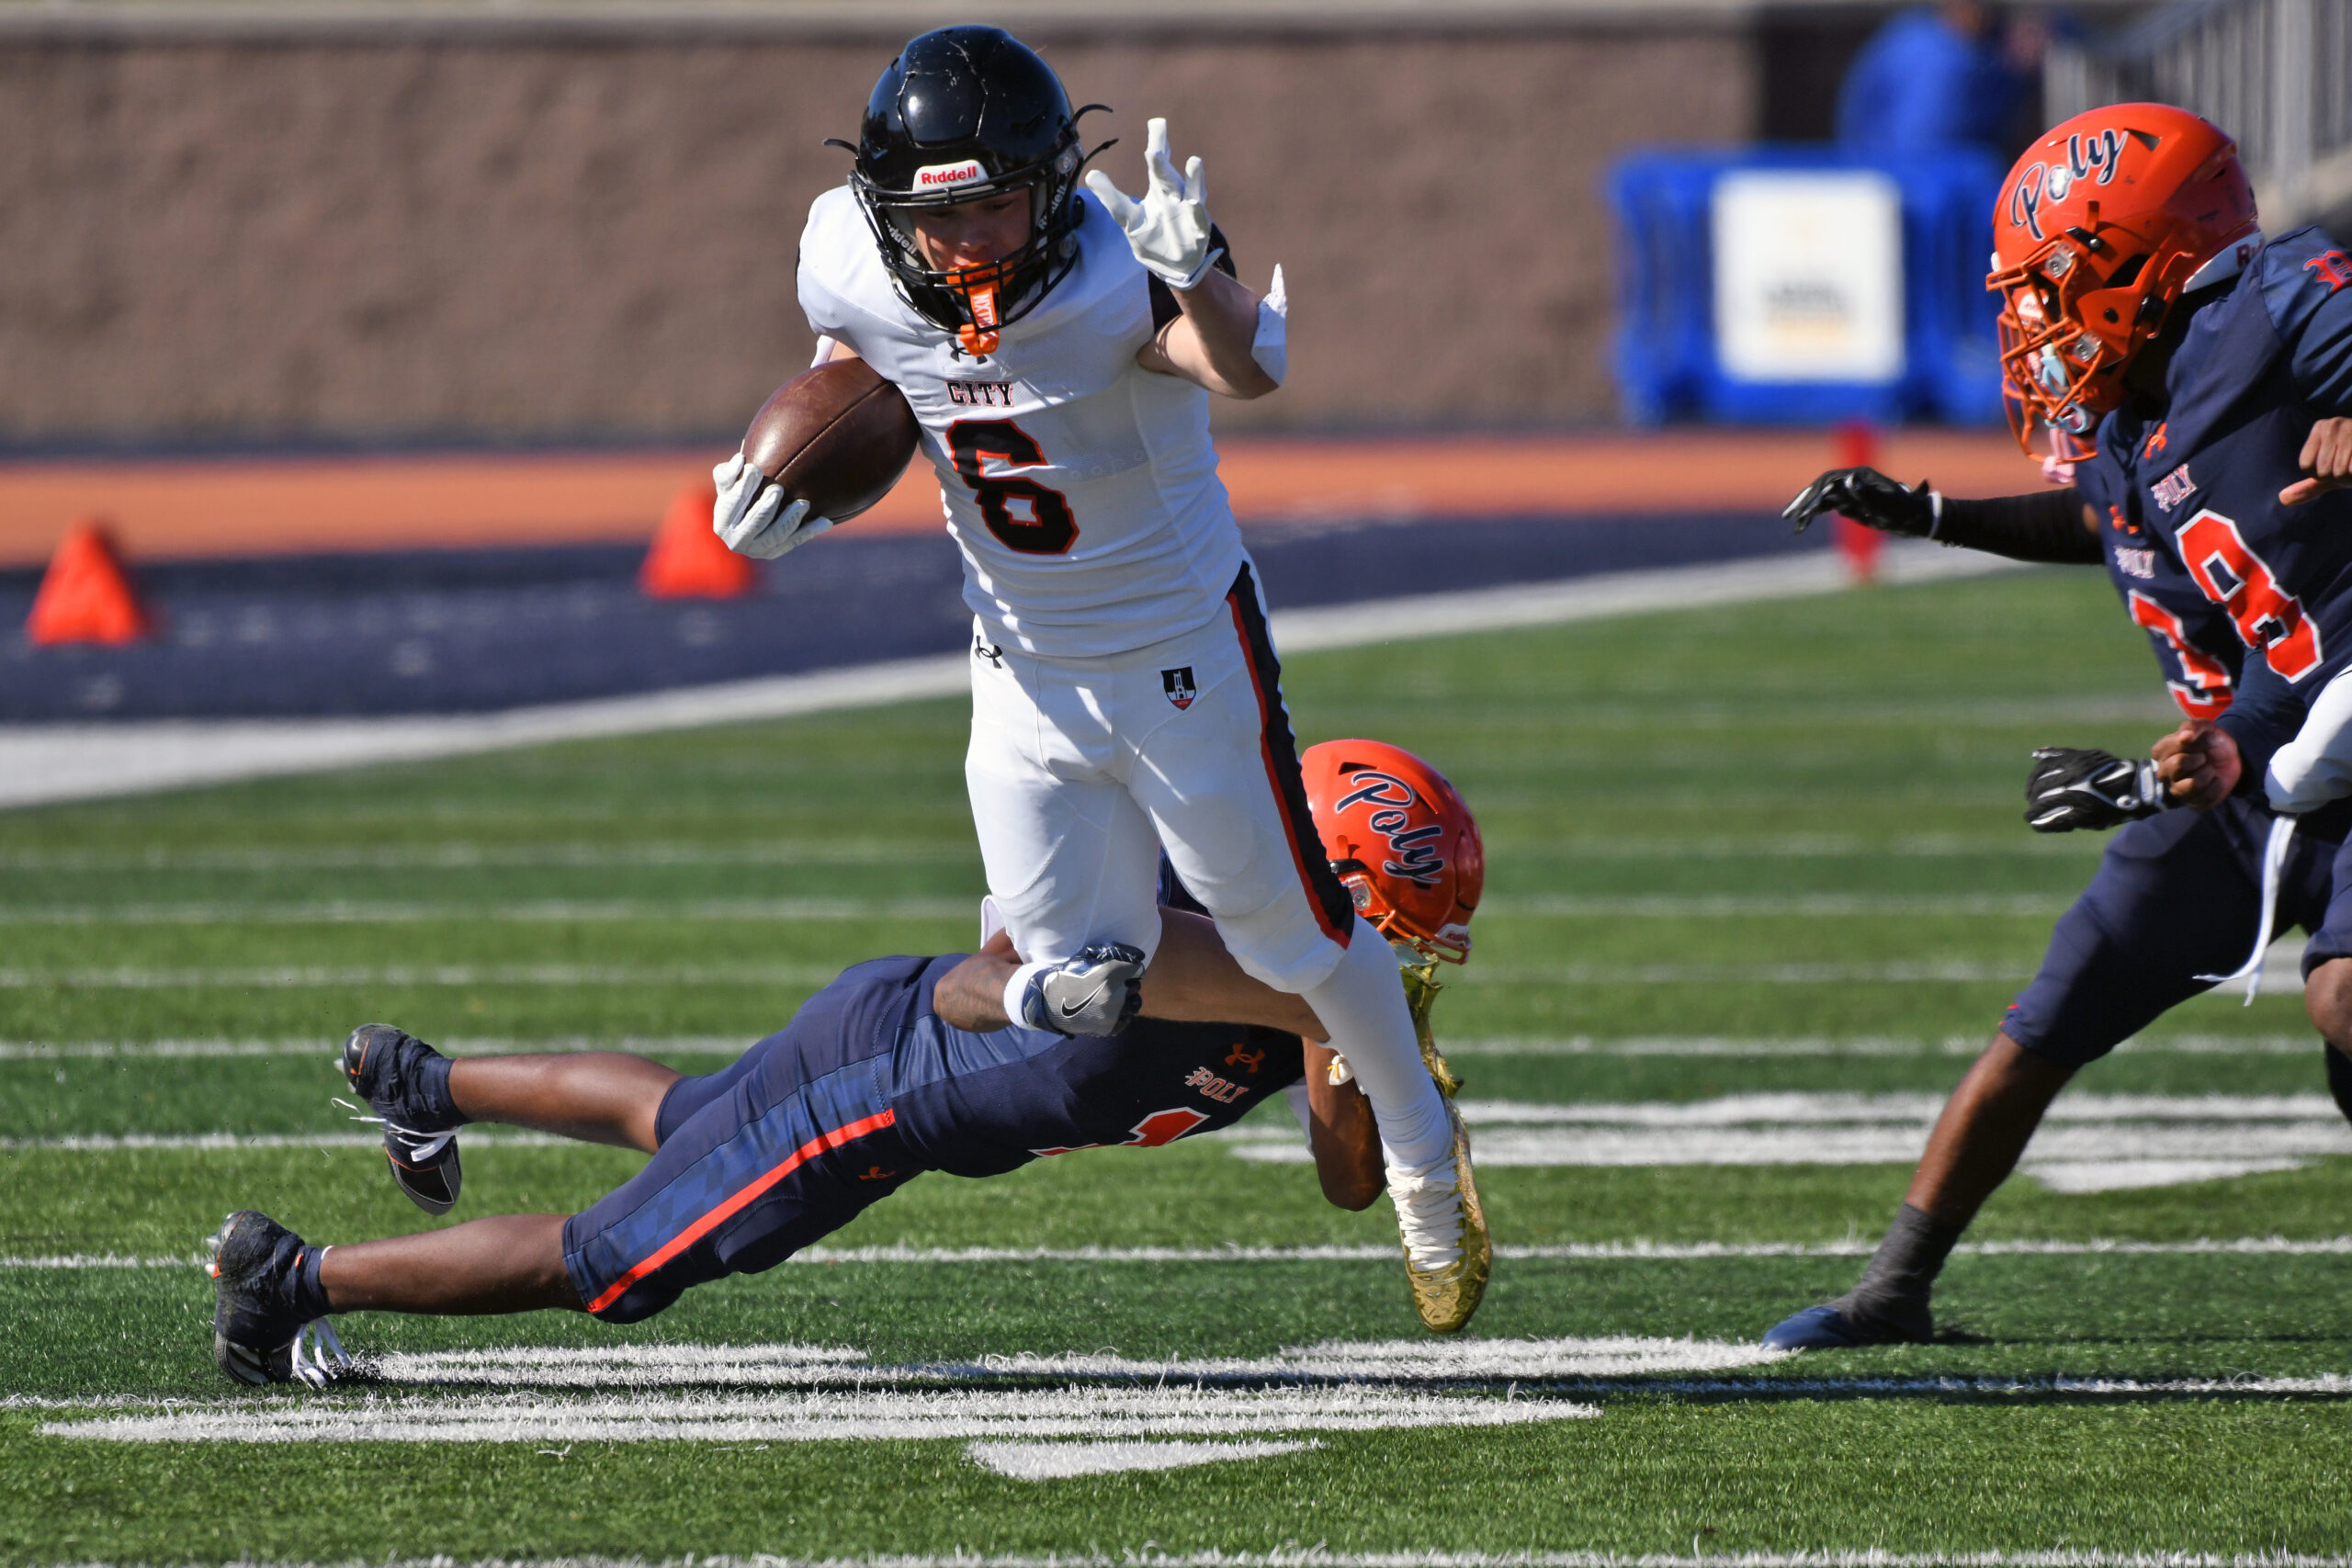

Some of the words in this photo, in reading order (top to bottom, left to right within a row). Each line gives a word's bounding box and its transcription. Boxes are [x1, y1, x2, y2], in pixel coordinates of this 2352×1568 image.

[921, 165, 978, 185] Riddell
[2011, 129, 2130, 241] Poly
[944, 380, 1015, 408] CITY
[945, 418, 1080, 555] 6
[2175, 508, 2324, 685] 8
[1335, 772, 1444, 885] Poly
[1184, 1066, 1250, 1103] POLY
